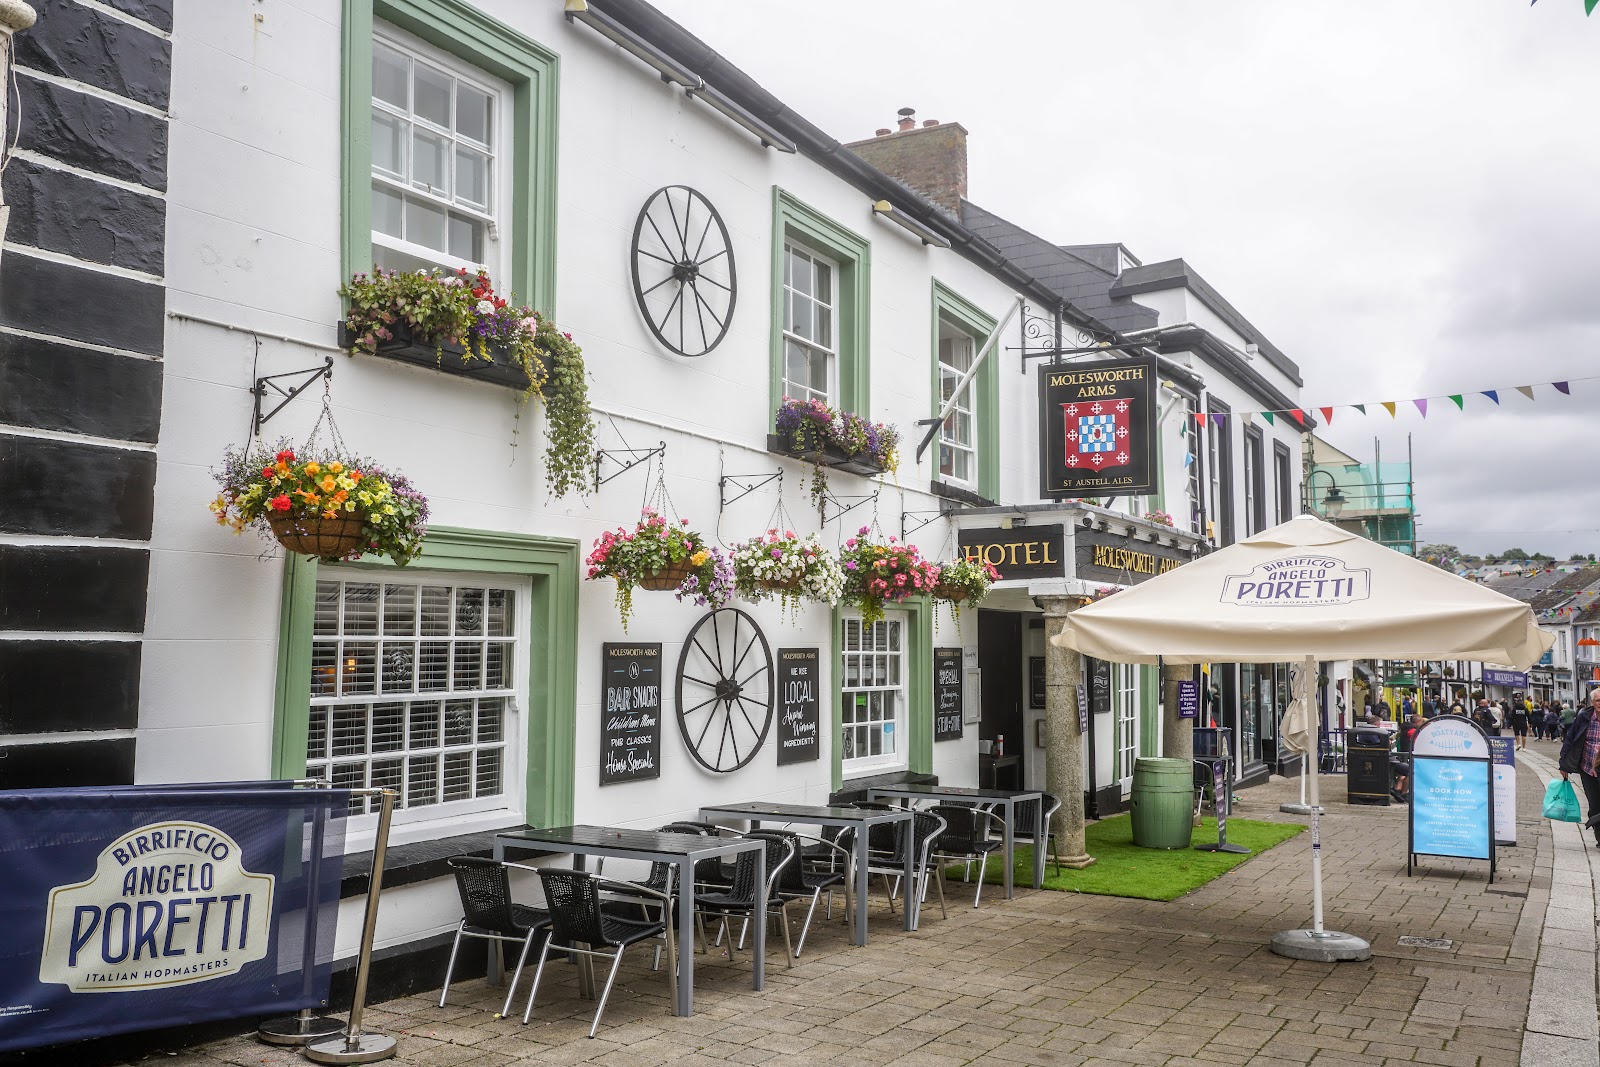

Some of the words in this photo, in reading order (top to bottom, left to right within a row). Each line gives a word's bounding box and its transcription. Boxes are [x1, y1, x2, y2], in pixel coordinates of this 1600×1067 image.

[1050, 368, 1143, 387] MOLESWORTH
[1077, 384, 1117, 398] ARMS
[1063, 479, 1072, 487] ST
[1075, 477, 1110, 487] AUSTELL
[1111, 476, 1133, 485] ALES
[963, 541, 1058, 566] HOTEL
[1094, 544, 1155, 575] MOLESWORTH
[1263, 558, 1336, 572] BIRRIFICIO
[1268, 569, 1326, 581] ANGELO
[1237, 577, 1354, 600] PORETTI
[607, 686, 631, 712] BAR
[632, 685, 658, 709] SNACKS
[784, 680, 815, 704] LOCAL
[626, 734, 652, 746] CLASSICS
[1430, 729, 1470, 739] BOATYARD
[112, 829, 229, 867] BIRRIFICIO
[122, 862, 214, 897] ANGELO
[68, 893, 253, 968] PORETTI
[86, 971, 138, 983] ITALIAN
[144, 958, 229, 979] HOPMASTERS
